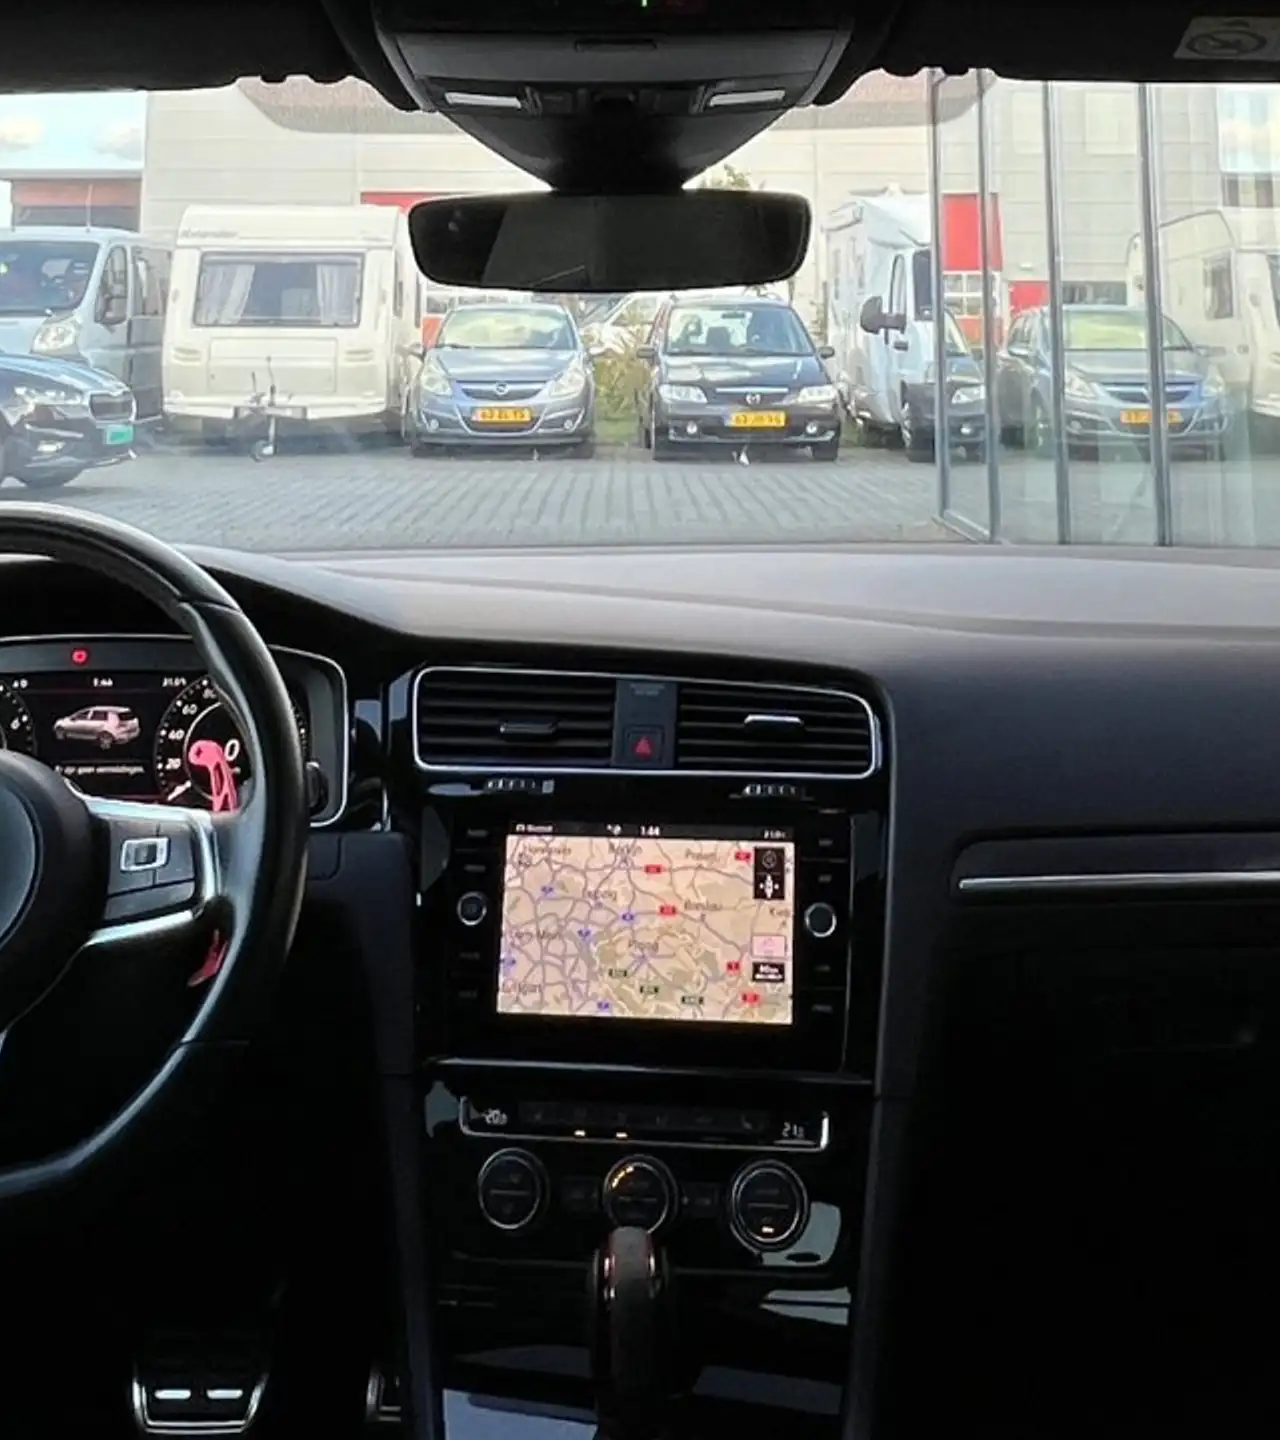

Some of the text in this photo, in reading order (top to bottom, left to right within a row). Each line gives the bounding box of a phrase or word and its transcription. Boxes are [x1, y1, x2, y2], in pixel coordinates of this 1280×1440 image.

[181, 703, 198, 716] 60
[10, 717, 21, 731] 6
[168, 728, 185, 741] 40
[224, 738, 241, 762] 0
[165, 757, 182, 771] 20
